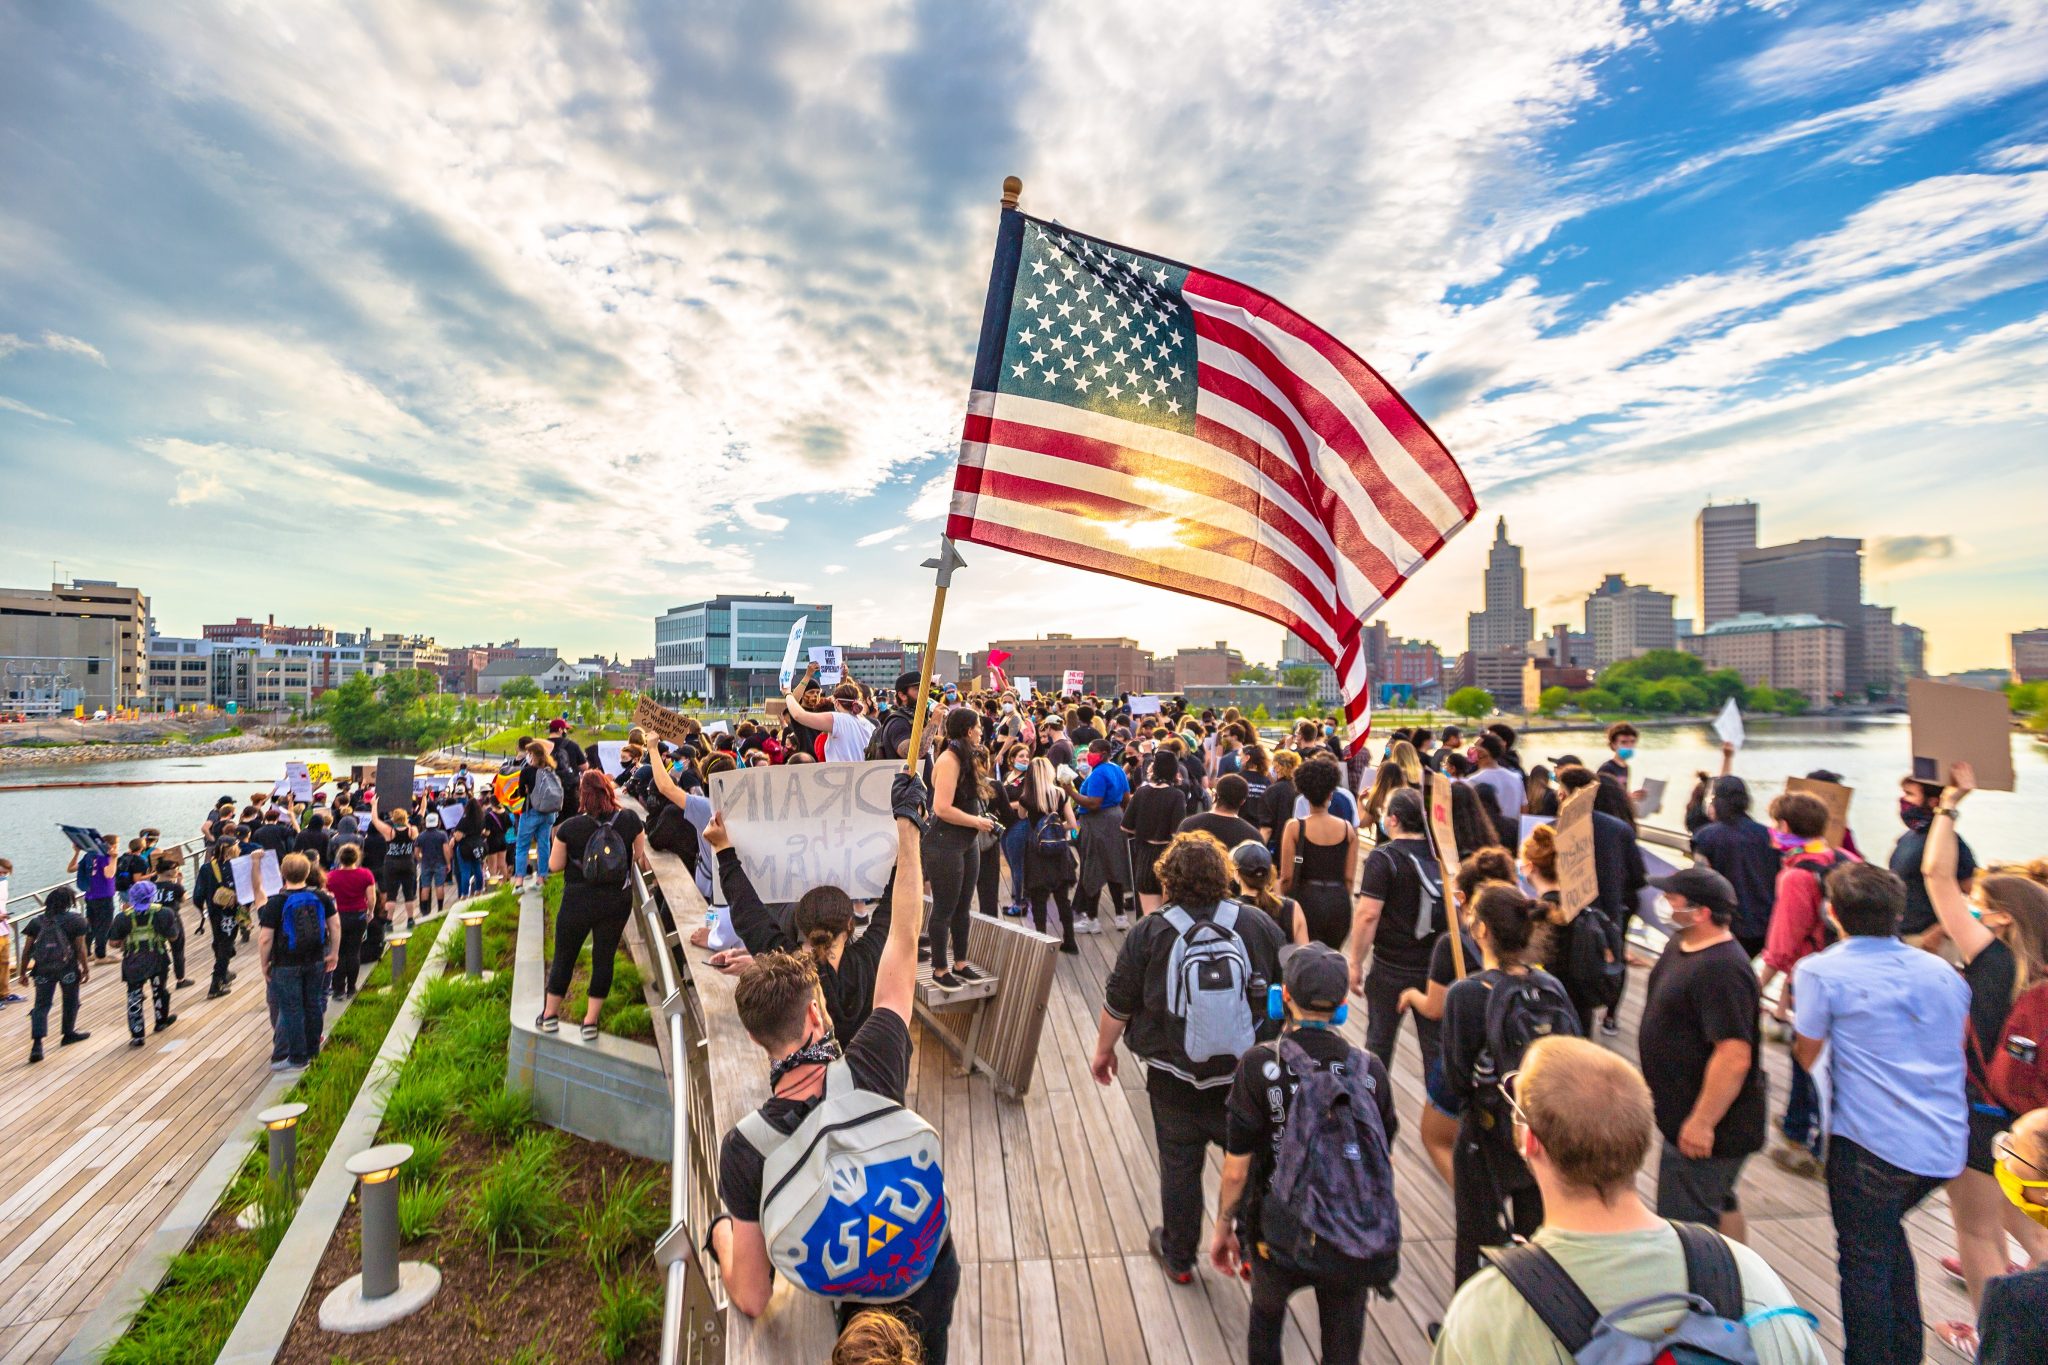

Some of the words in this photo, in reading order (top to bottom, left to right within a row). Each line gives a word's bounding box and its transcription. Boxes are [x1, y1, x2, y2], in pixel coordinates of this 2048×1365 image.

[640, 706, 649, 716] DO
[651, 713, 671, 729] WHEN
[672, 725, 685, 734] YOU
[641, 698, 658, 713] WHAT
[660, 711, 676, 723] WILL
[677, 718, 690, 728] YOU
[641, 719, 652, 729] GO
[653, 726, 677, 739] HOME?
